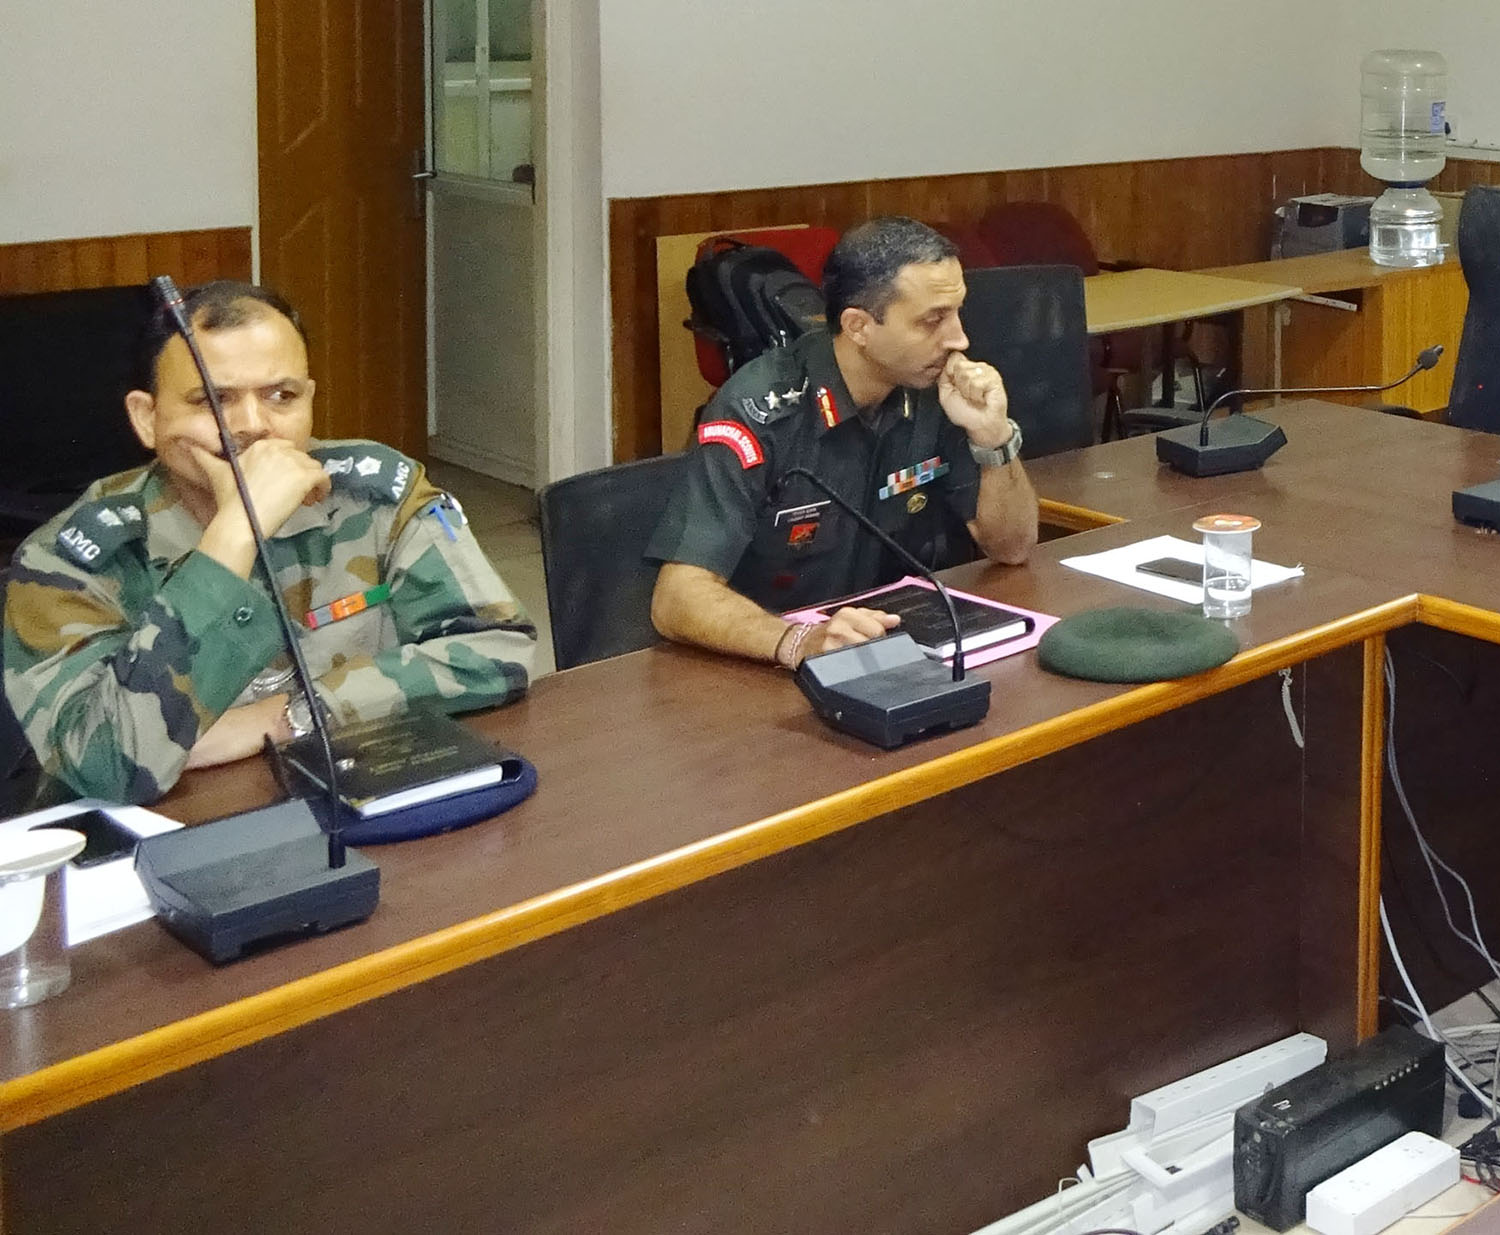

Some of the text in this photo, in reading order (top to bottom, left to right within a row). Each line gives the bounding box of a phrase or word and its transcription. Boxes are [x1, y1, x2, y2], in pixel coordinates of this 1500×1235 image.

[738, 435, 758, 463] SCOUTS
[391, 461, 410, 499] AMC
[60, 527, 101, 560] AMC
